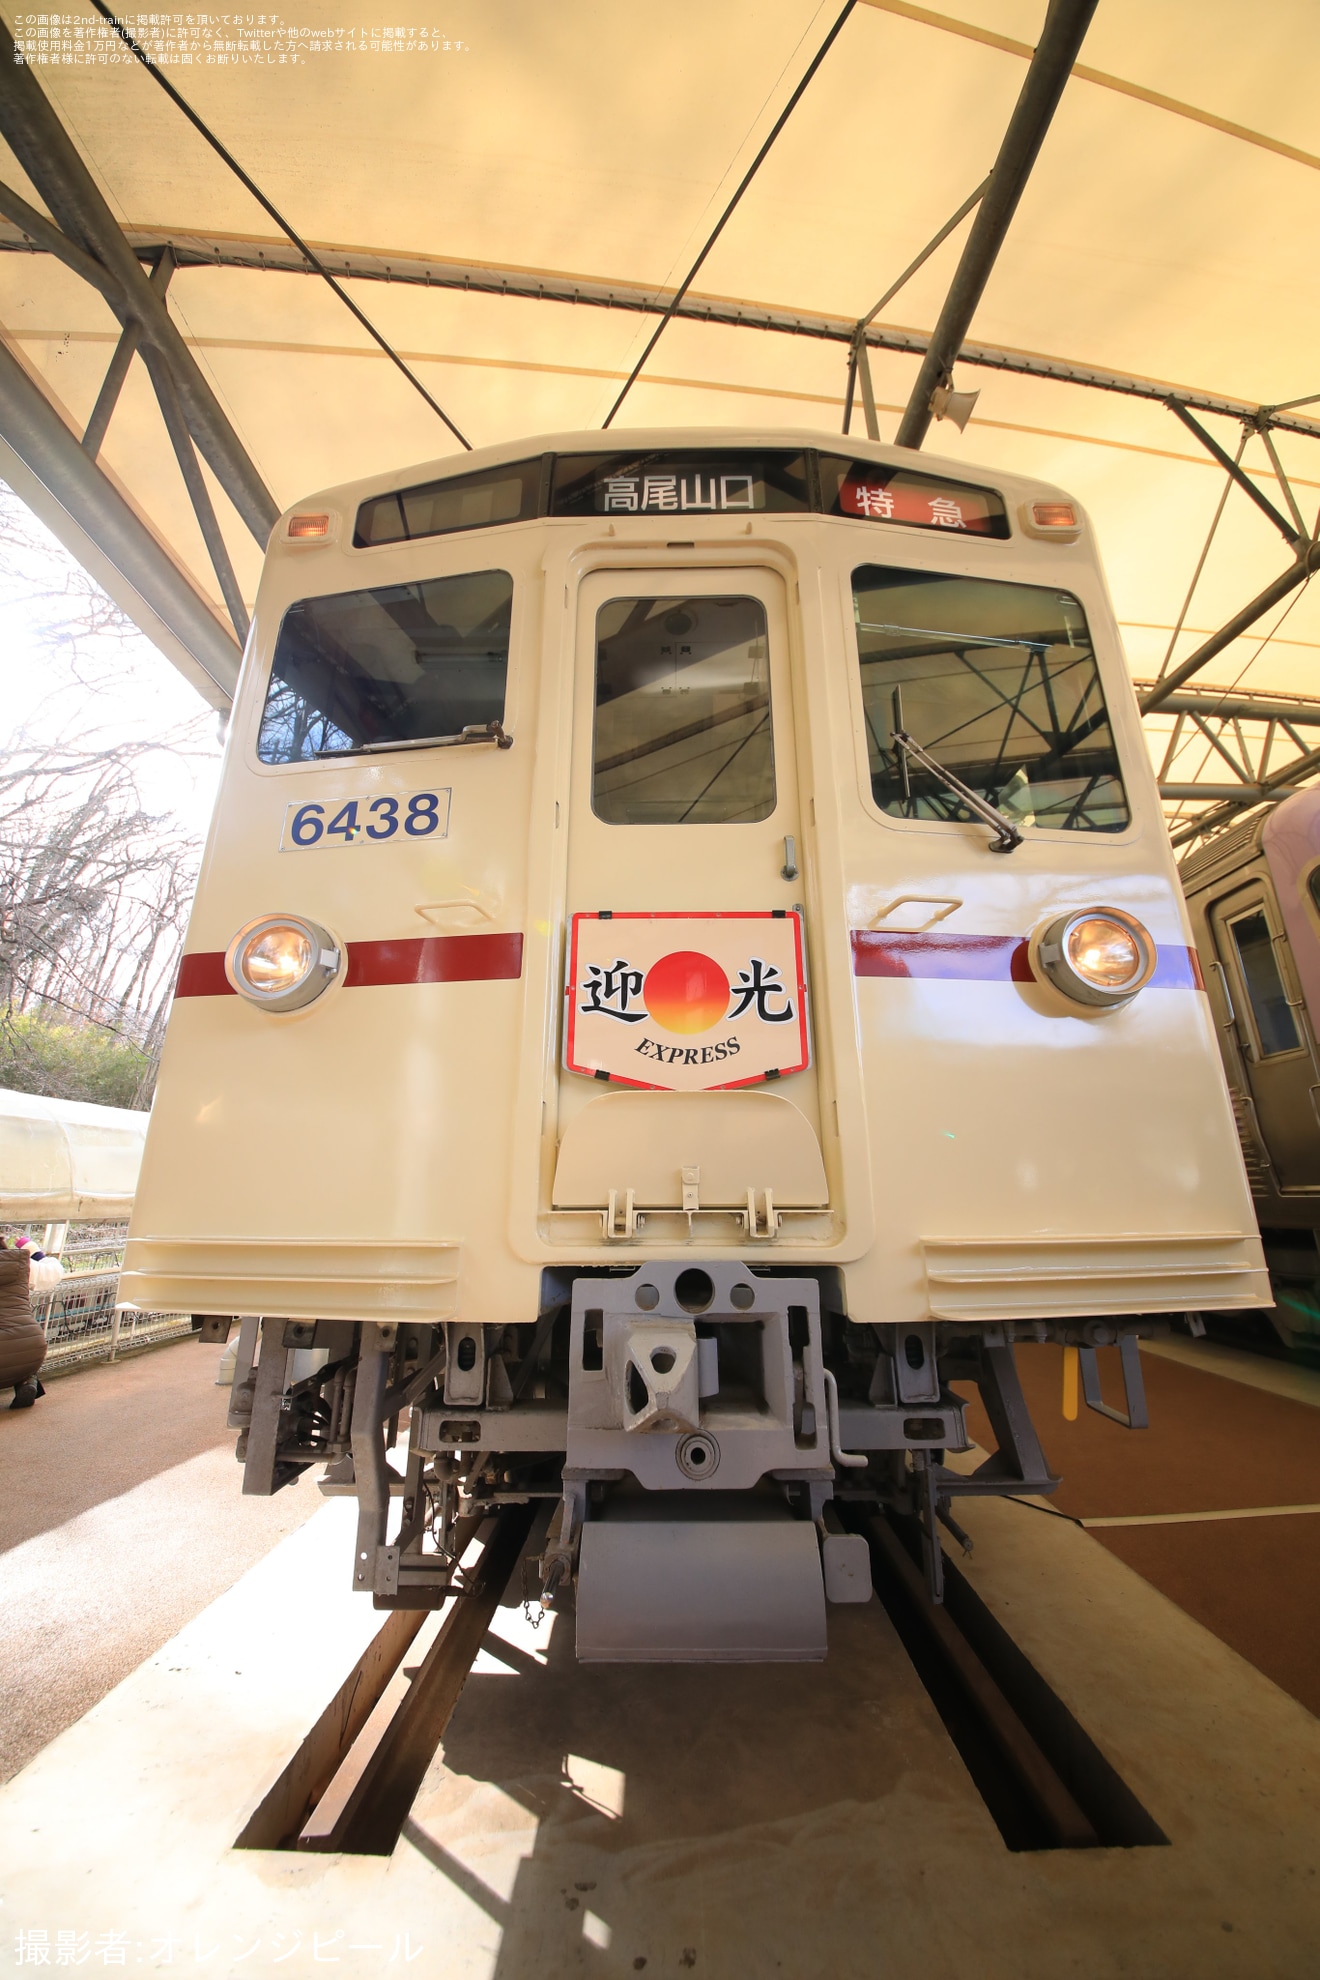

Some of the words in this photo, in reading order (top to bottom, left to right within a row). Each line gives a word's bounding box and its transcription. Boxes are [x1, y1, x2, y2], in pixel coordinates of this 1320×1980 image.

[603, 474, 755, 511] 高尾山口
[291, 793, 439, 846] 6438
[634, 1036, 741, 1065] EXPRESS
